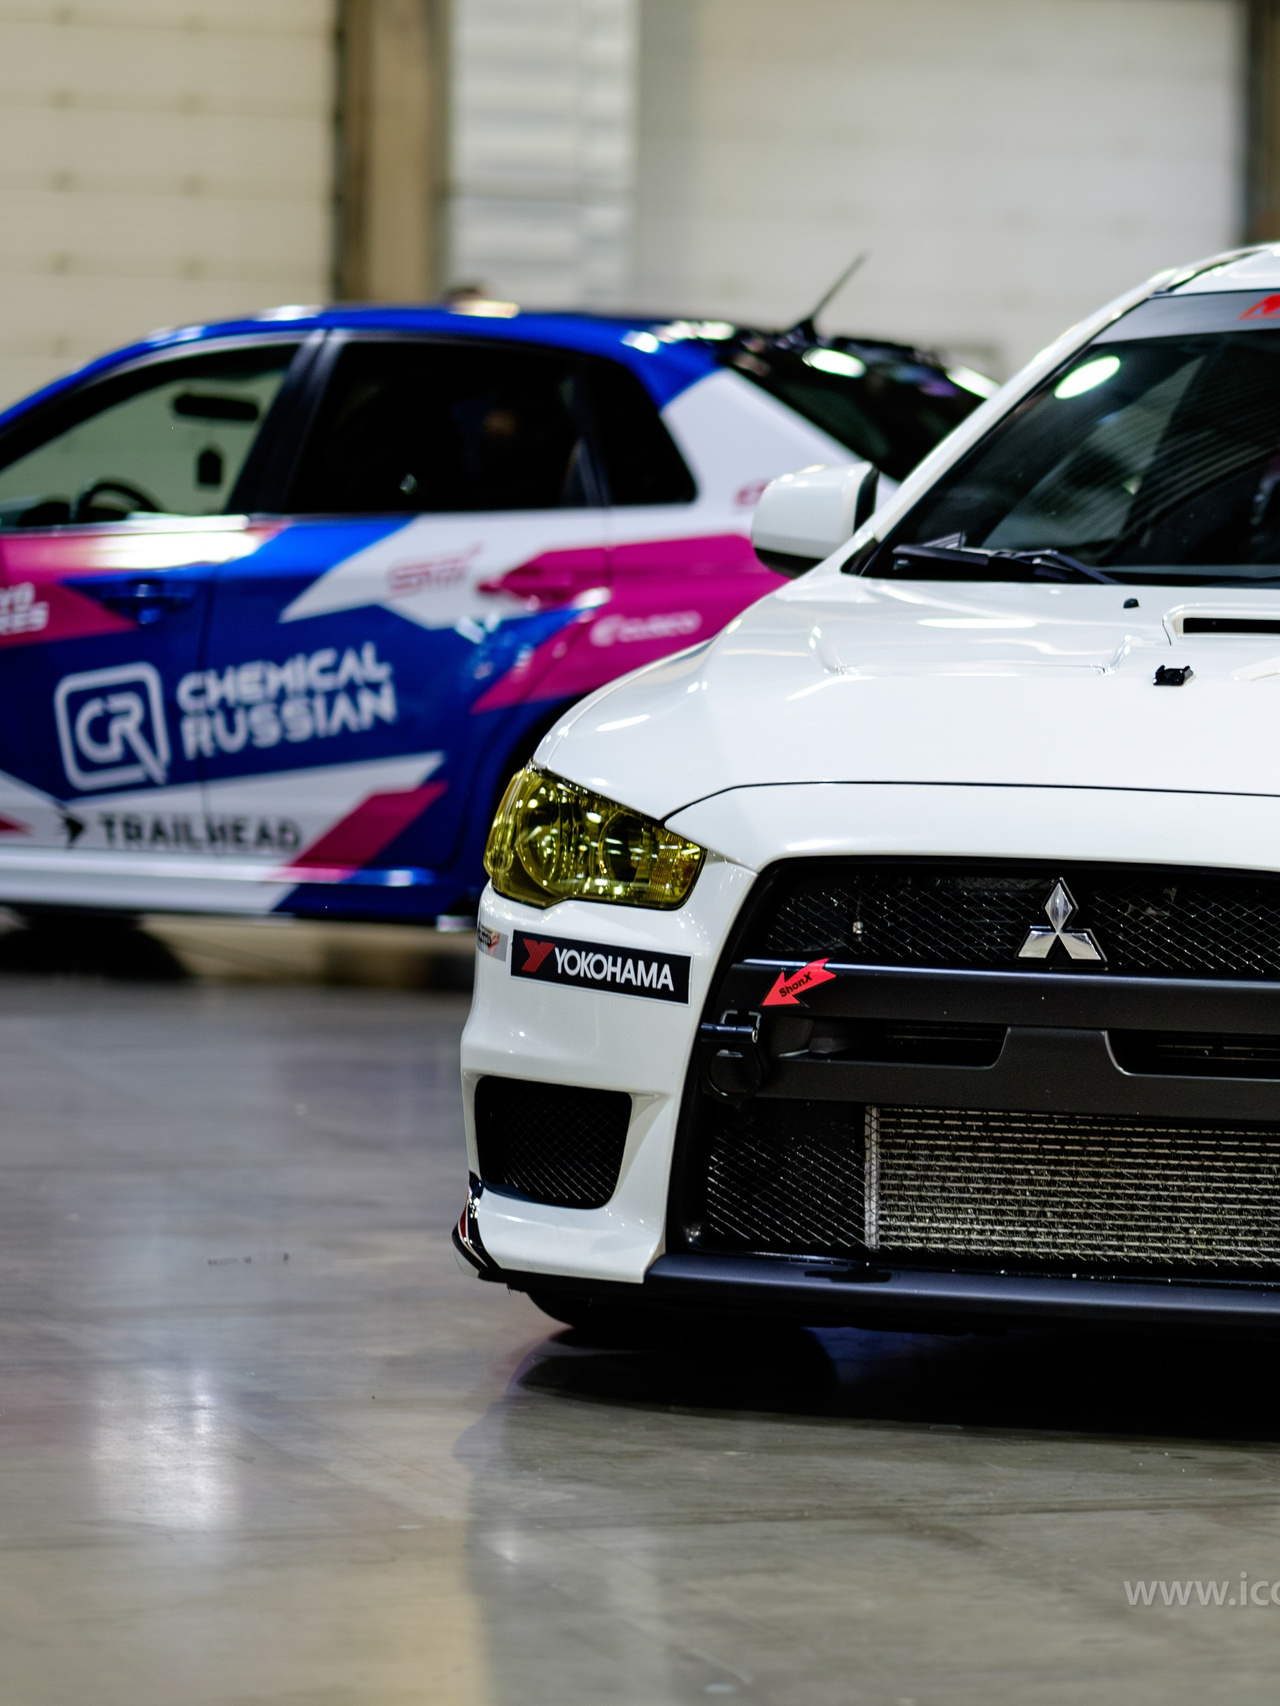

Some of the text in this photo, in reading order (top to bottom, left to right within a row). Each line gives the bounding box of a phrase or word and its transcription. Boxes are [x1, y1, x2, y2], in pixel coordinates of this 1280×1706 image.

[177, 641, 393, 713] CHEMICAL
[181, 681, 398, 760] RUSSIAN
[100, 812, 303, 852] TRAILHEAD
[554, 947, 675, 992] YOKOHAMA
[779, 971, 813, 998] ShonX
